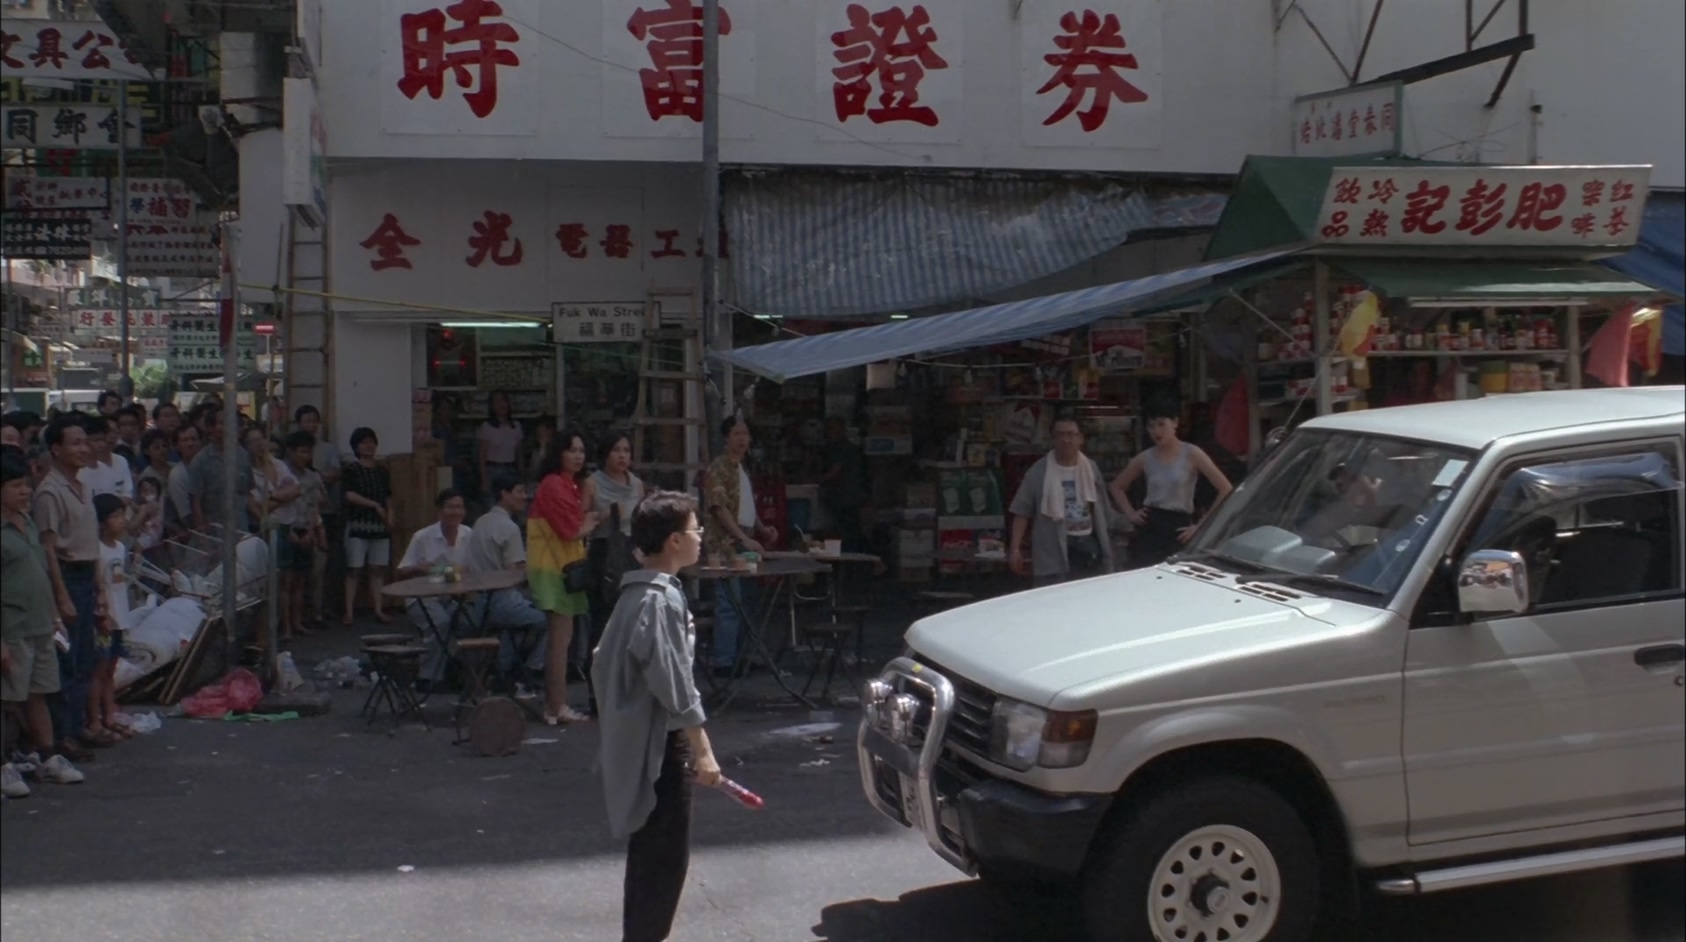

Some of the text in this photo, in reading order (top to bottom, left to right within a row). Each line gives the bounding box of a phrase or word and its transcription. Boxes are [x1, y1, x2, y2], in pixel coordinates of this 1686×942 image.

[397, 0, 1149, 132] 時富證券
[558, 306, 581, 317] Fuk
[587, 306, 607, 317] Wa
[578, 321, 636, 337] 福華街
